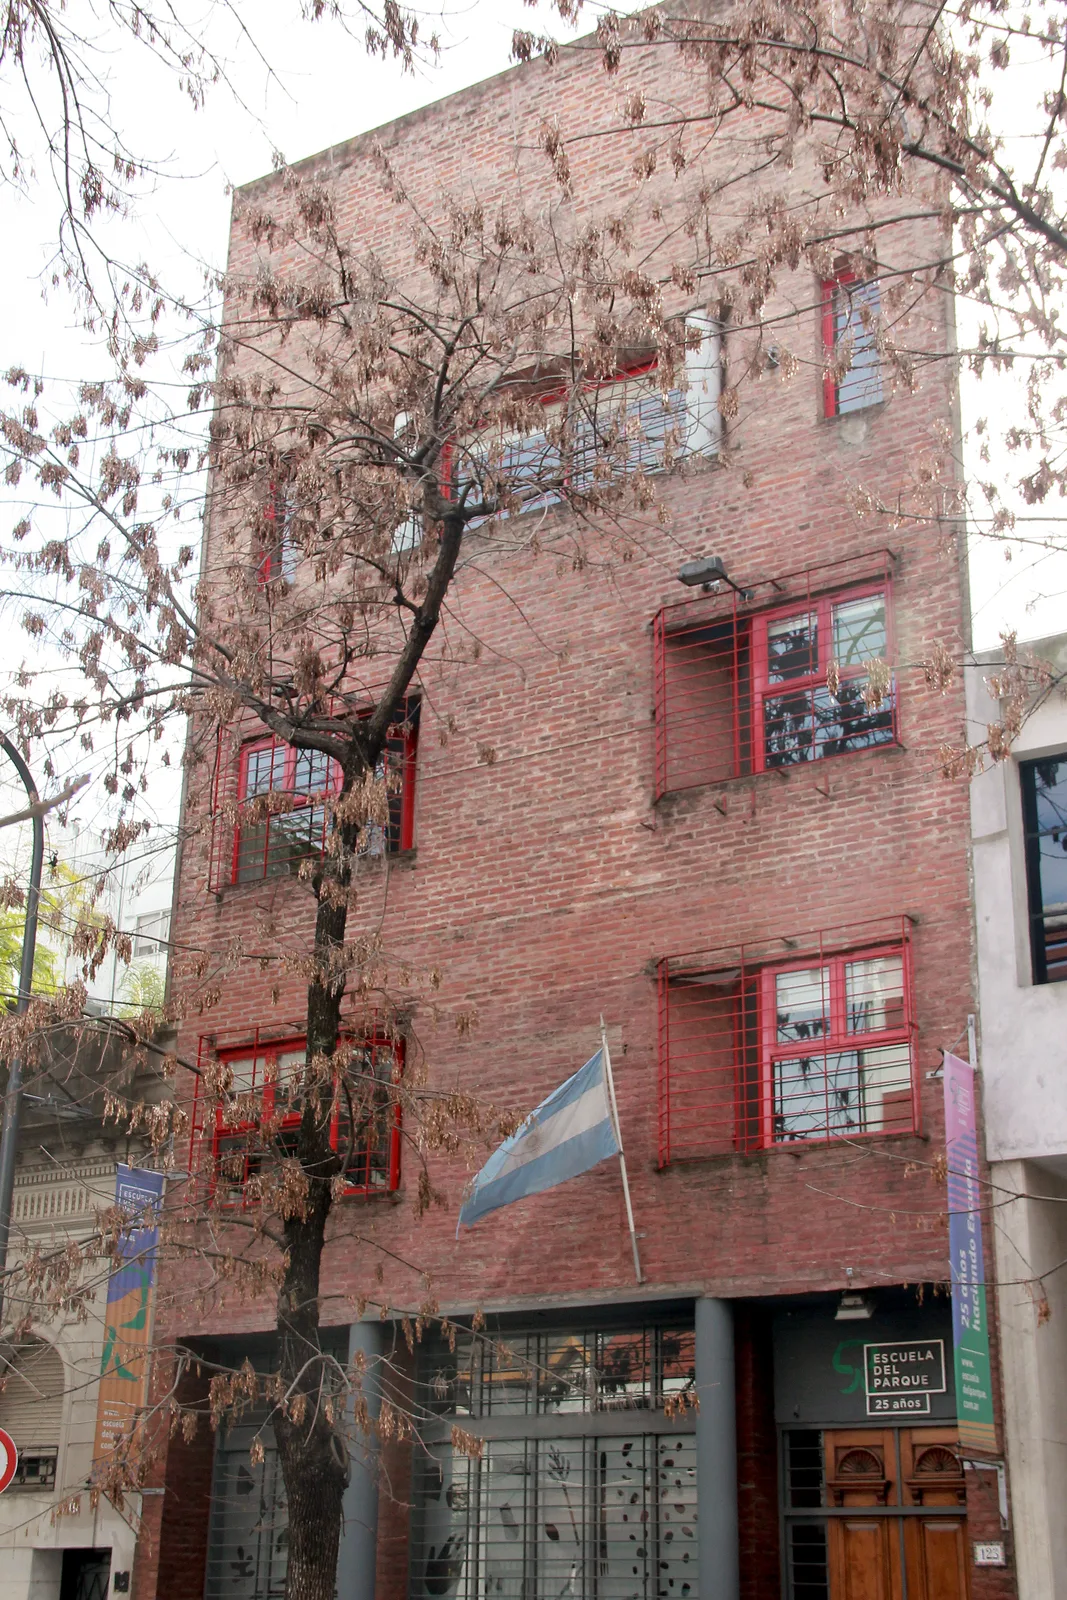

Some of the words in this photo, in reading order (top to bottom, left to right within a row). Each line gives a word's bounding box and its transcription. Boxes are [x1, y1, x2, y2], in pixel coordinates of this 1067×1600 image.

[960, 1302, 970, 1329] 25
[873, 1350, 934, 1364] ESCUELA
[873, 1364, 900, 1375] DEL
[873, 1375, 929, 1388] PARQUE
[875, 1400, 890, 1409] 25
[892, 1398, 922, 1409] años
[981, 1547, 999, 1560] 123
